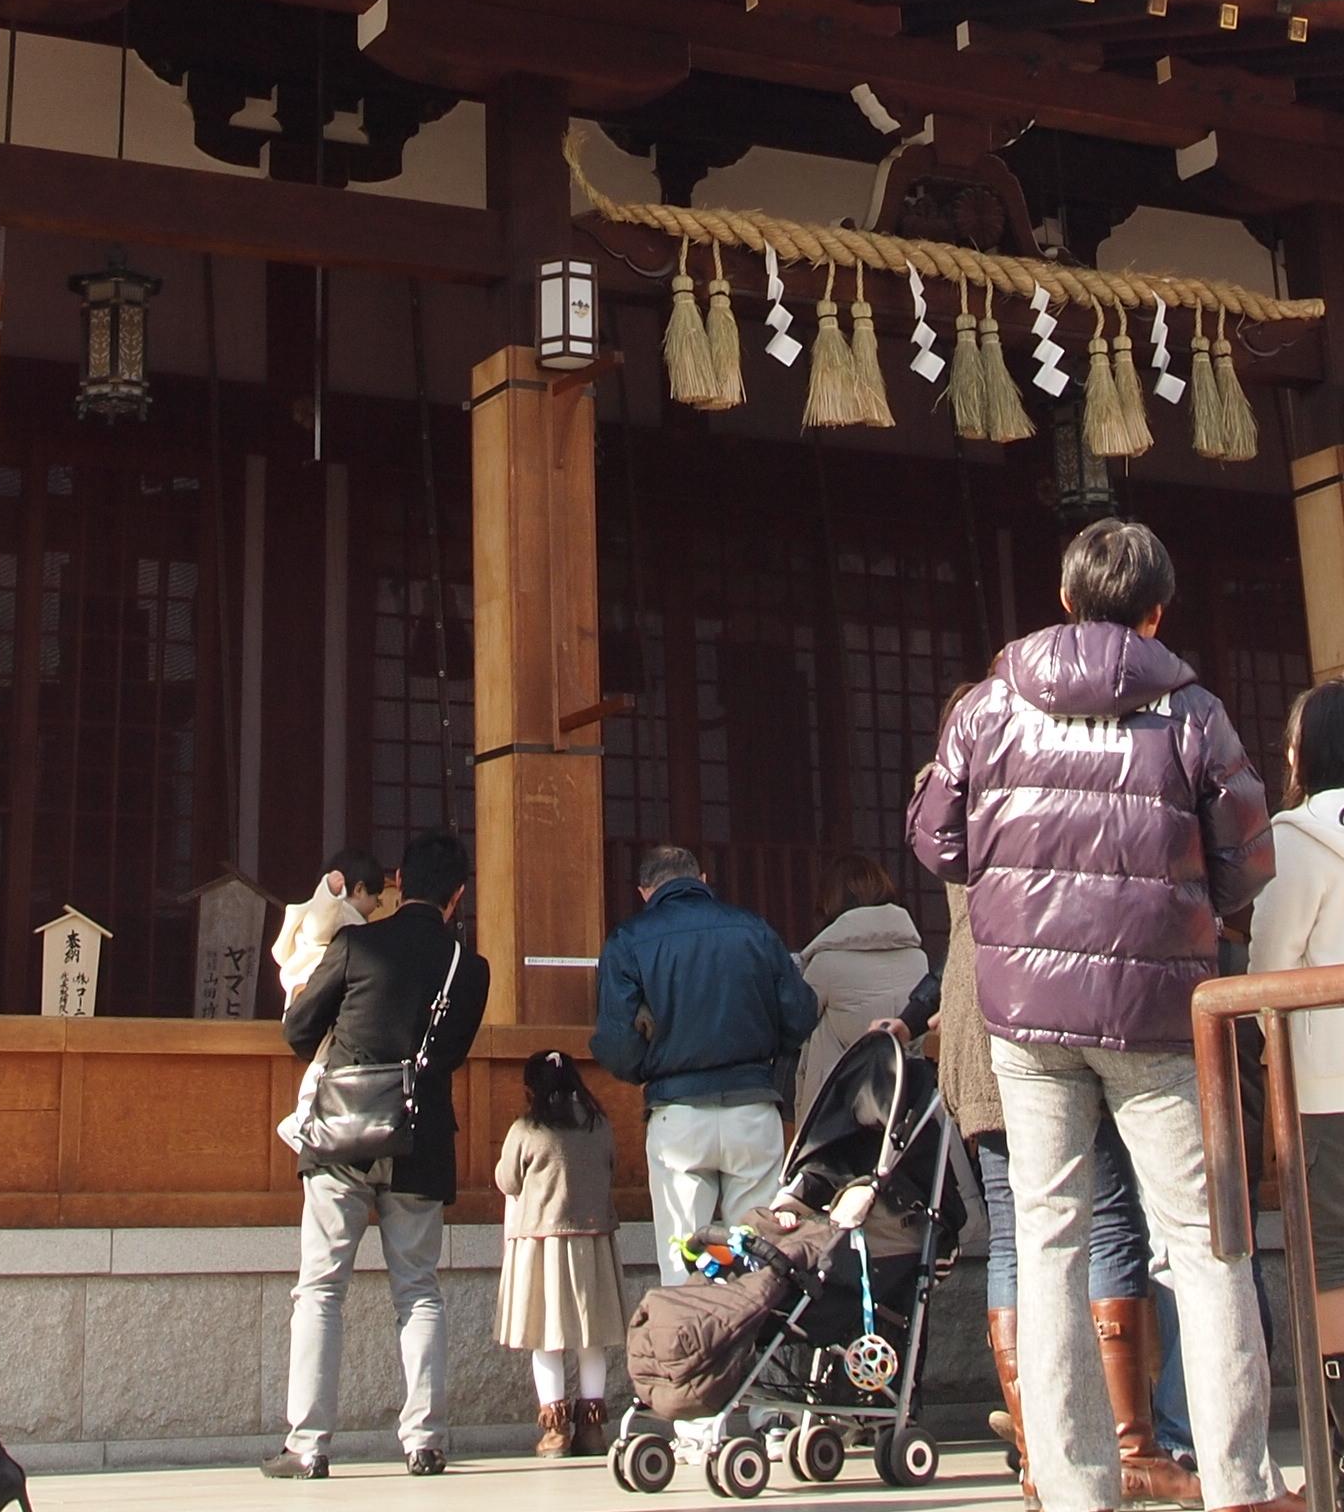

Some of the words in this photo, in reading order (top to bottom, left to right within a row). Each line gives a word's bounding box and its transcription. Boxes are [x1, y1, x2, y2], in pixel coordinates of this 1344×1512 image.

[1008, 709, 1135, 768] TRAIL
[63, 929, 81, 964] 奉納
[223, 946, 247, 1017] ヤマヒ
